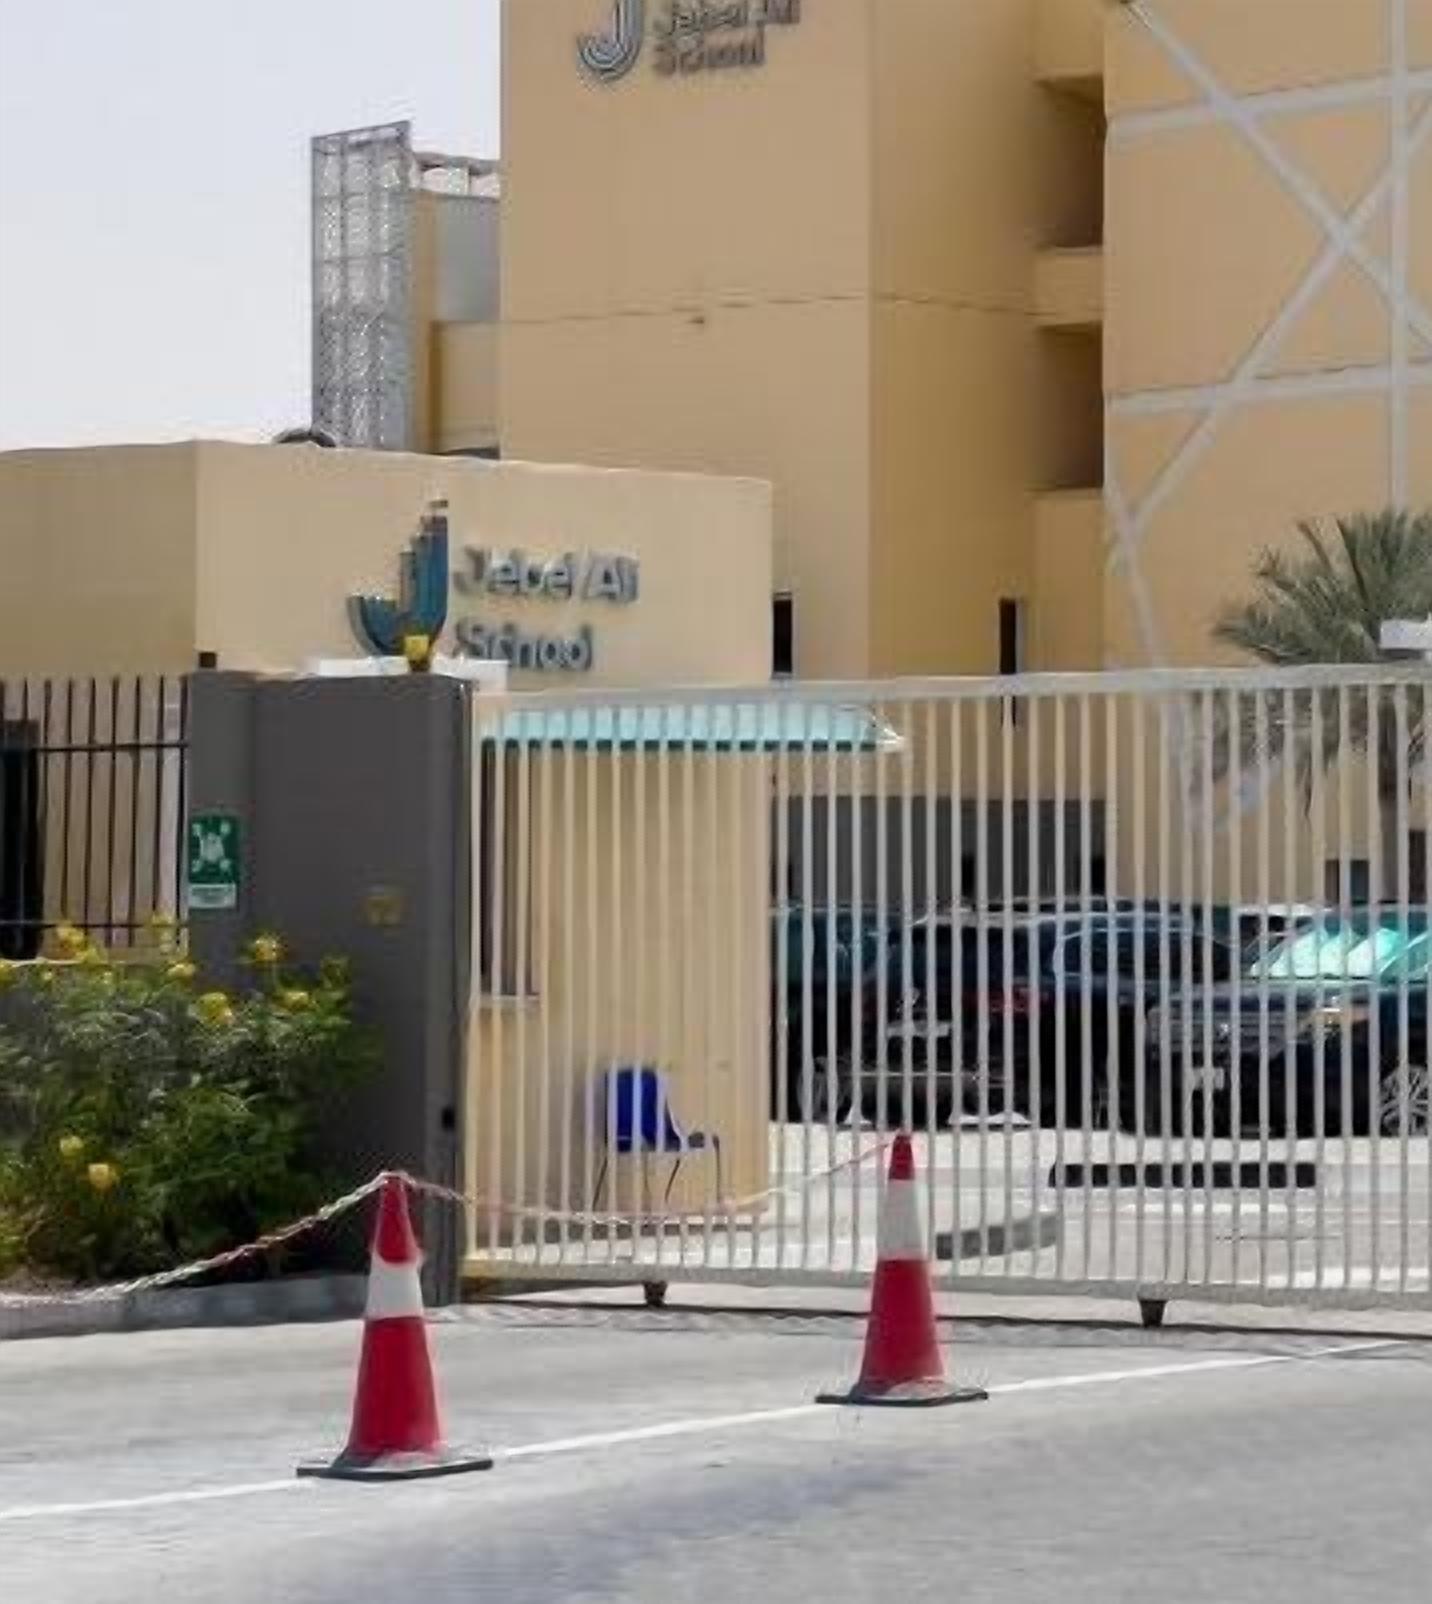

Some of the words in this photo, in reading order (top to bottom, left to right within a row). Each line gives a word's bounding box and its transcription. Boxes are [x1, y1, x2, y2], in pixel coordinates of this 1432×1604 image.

[453, 546, 573, 597] Jebel
[580, 548, 639, 603] Ali
[455, 615, 593, 673] School
